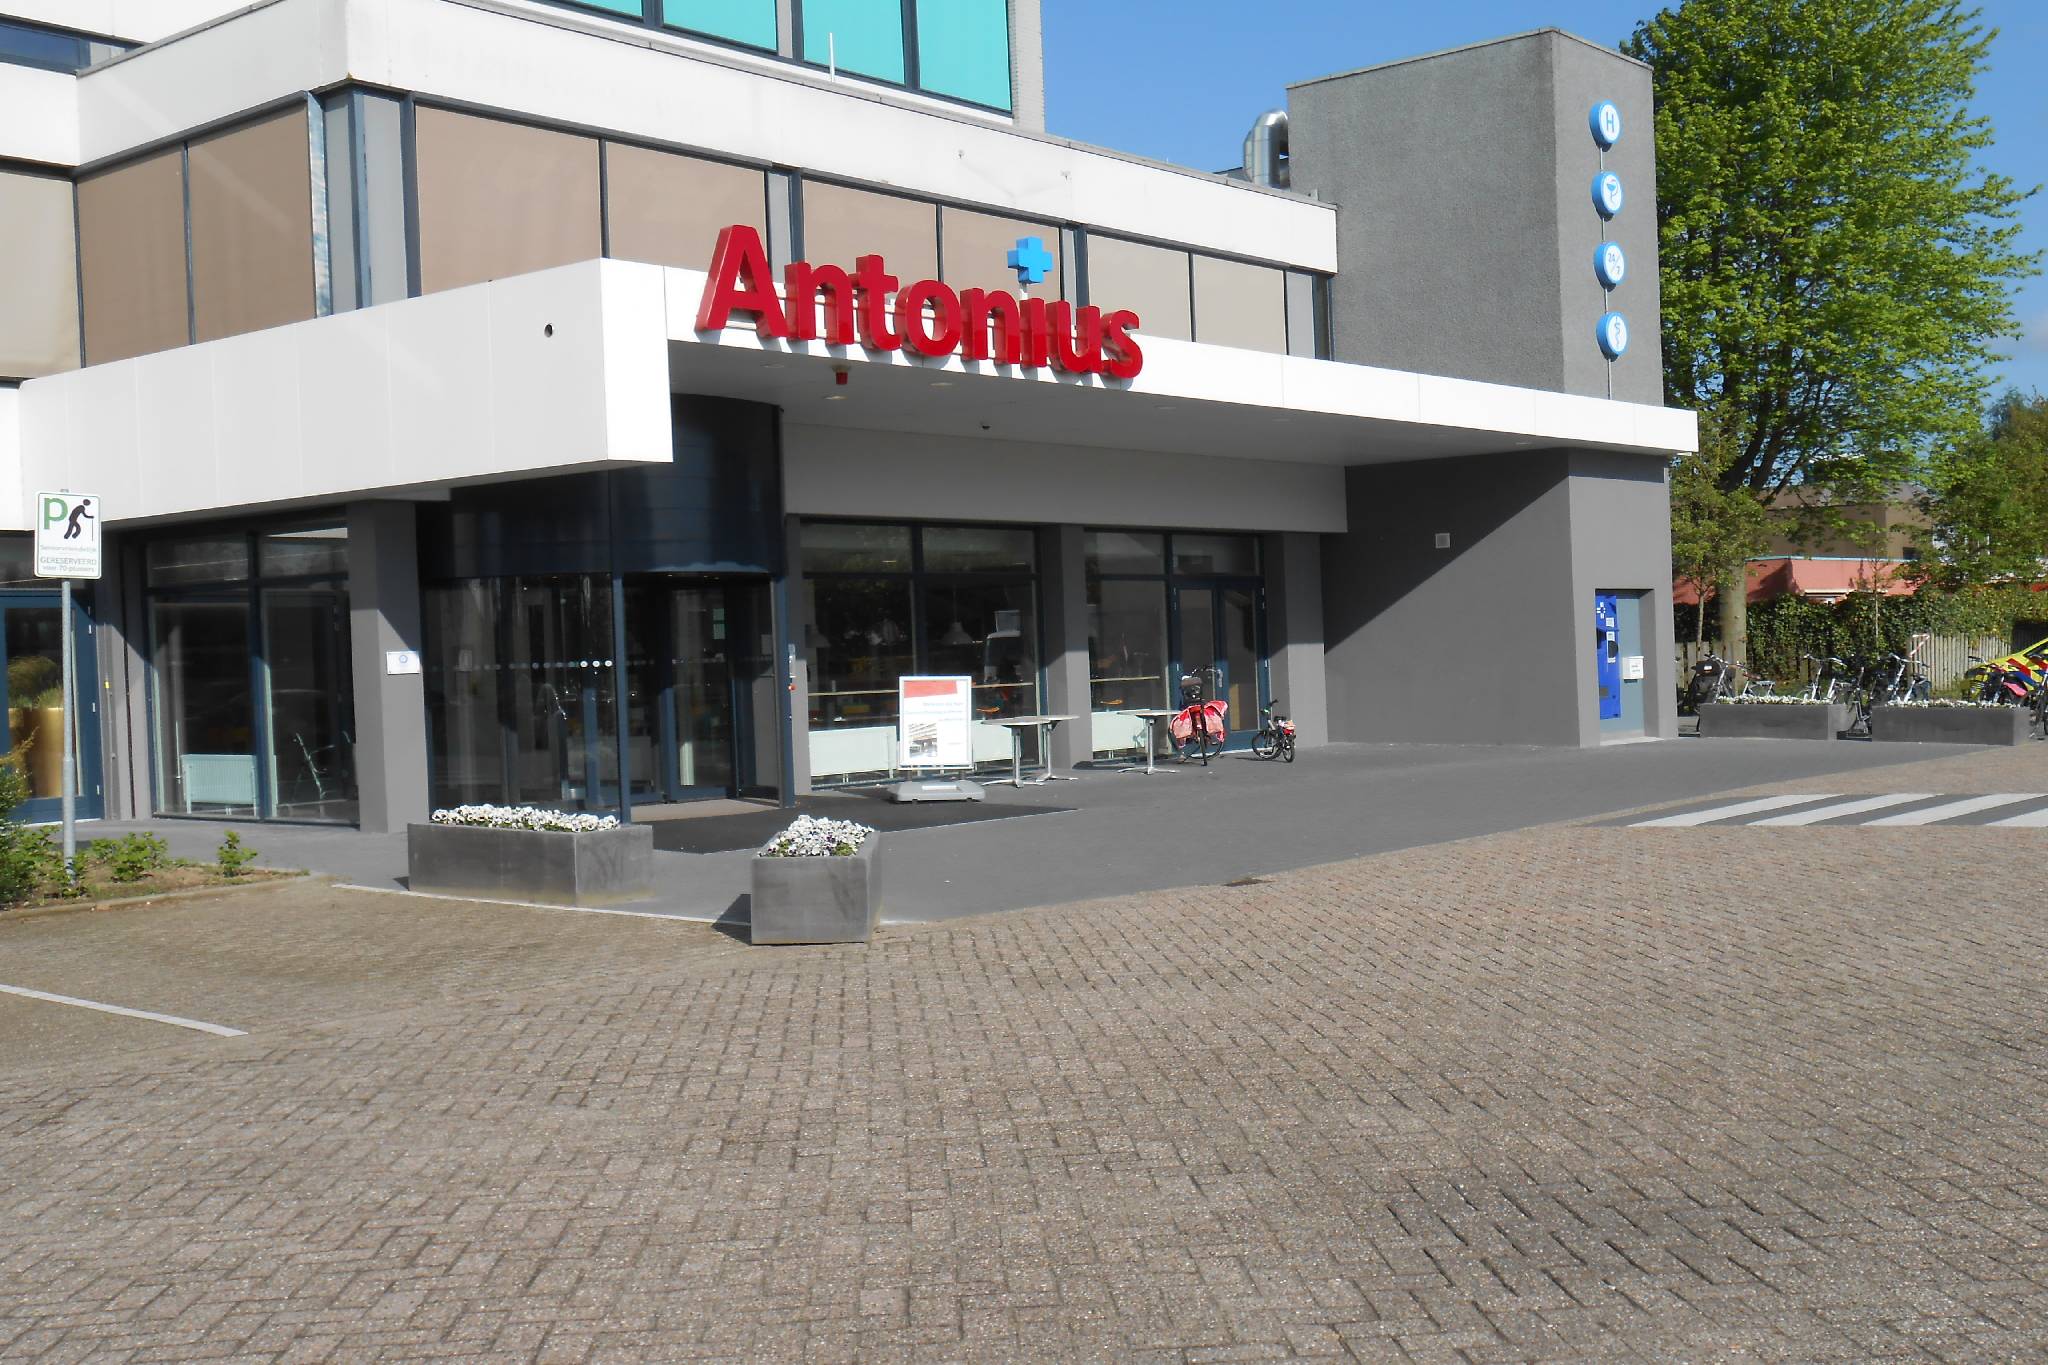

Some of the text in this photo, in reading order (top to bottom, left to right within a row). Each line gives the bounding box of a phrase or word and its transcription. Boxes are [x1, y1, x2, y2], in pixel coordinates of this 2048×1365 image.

[1606, 111, 1615, 133] H
[695, 224, 1143, 378] Antonius
[44, 498, 68, 529] P
